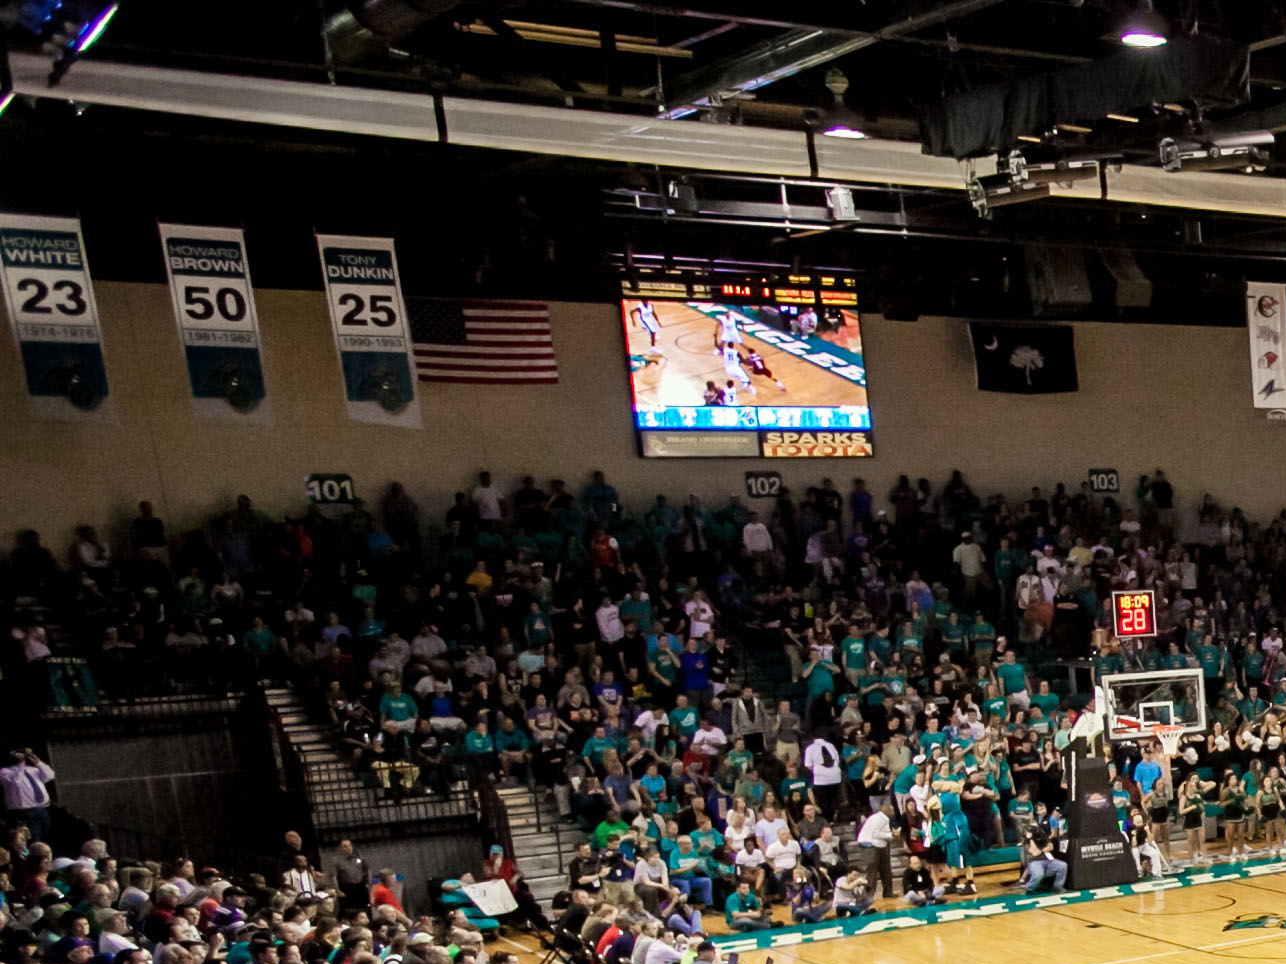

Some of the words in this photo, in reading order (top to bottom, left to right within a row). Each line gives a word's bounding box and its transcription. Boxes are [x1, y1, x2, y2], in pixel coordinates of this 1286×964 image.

[2, 236, 78, 250] HOWARD
[5, 249, 81, 266] WHITE
[168, 245, 240, 259] HOWARD
[339, 254, 377, 265] TONY
[170, 257, 244, 273] BROWN
[328, 265, 393, 280] DUNKIN
[17, 279, 87, 316] 23
[185, 286, 247, 321] 50
[338, 293, 397, 327] 25
[767, 432, 867, 444] SPARKS
[764, 444, 868, 456] TOYOTA
[307, 479, 353, 500] 101
[748, 477, 781, 495] 102
[1090, 473, 1117, 490] 103
[1118, 594, 1149, 608] 18:09
[1122, 609, 1147, 632] 28
